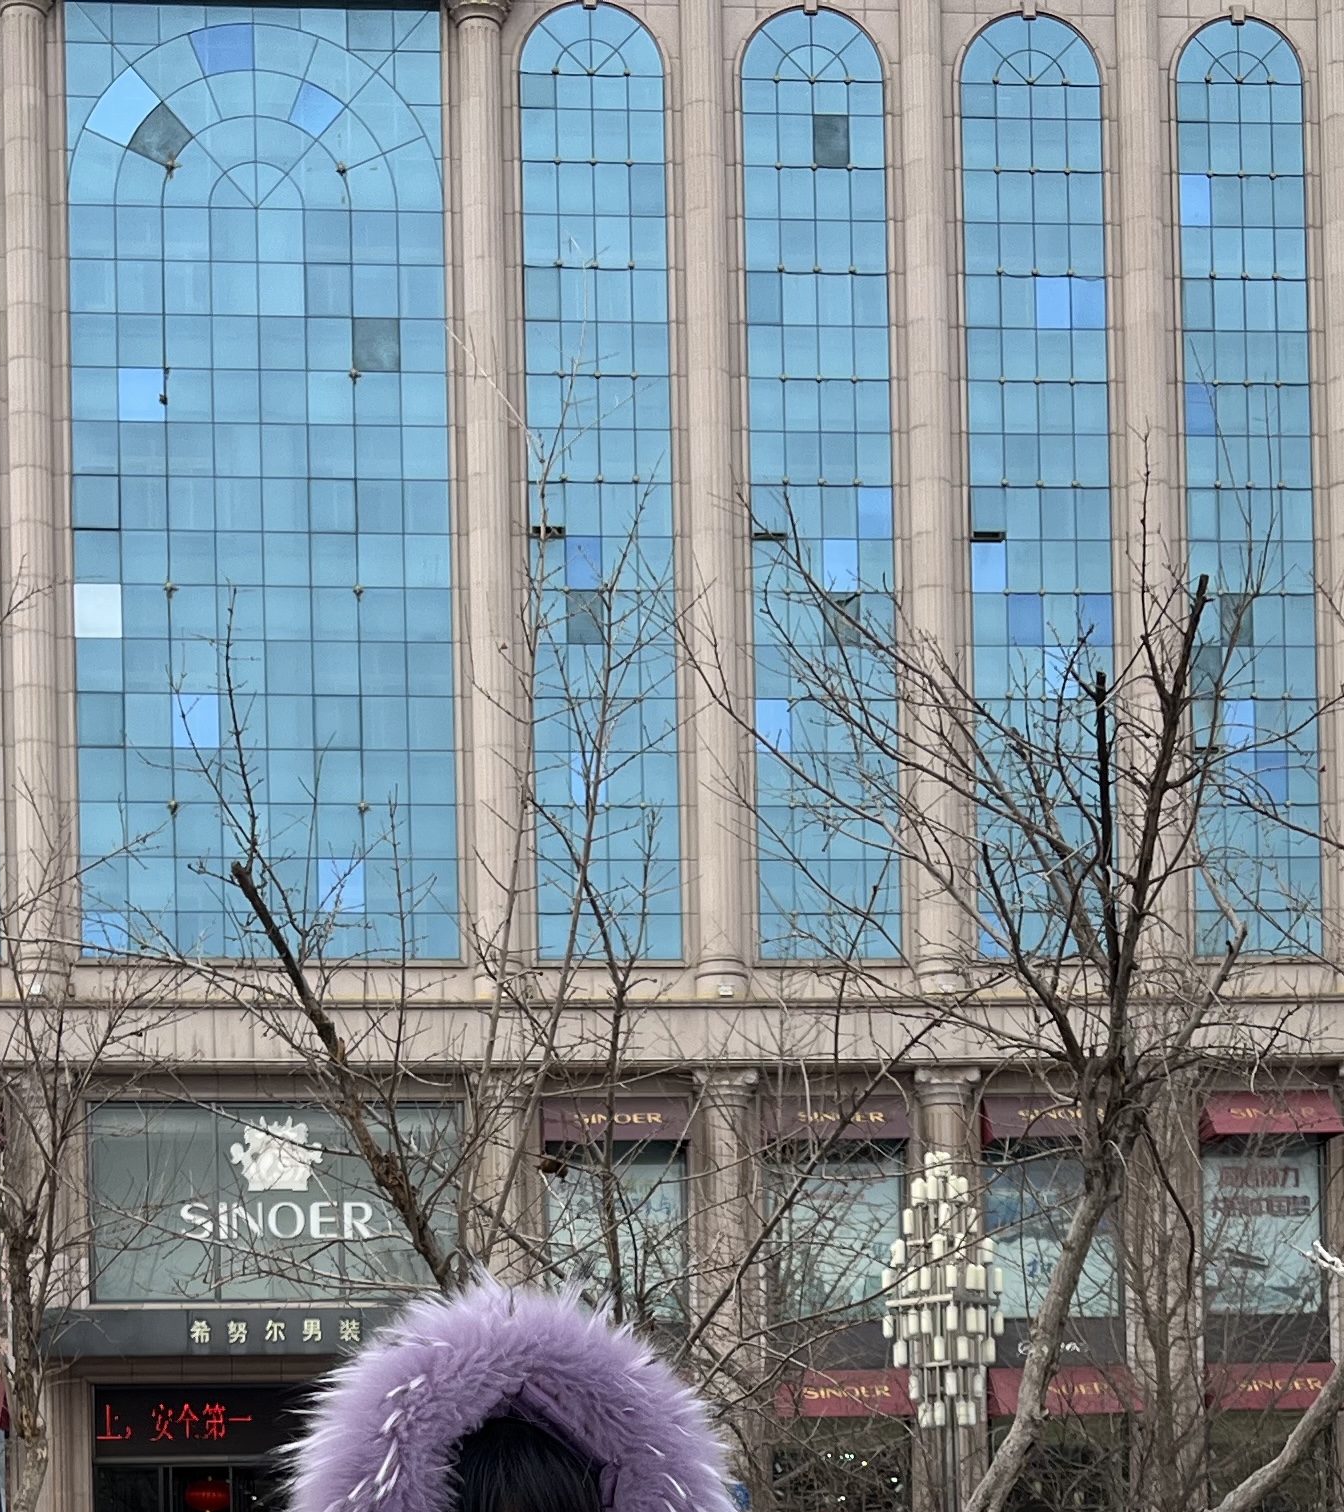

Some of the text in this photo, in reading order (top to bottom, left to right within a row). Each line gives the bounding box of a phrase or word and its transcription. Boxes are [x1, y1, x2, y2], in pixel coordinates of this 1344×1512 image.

[179, 1201, 374, 1241] SINOER
[190, 1318, 362, 1345] 希努尔男装
